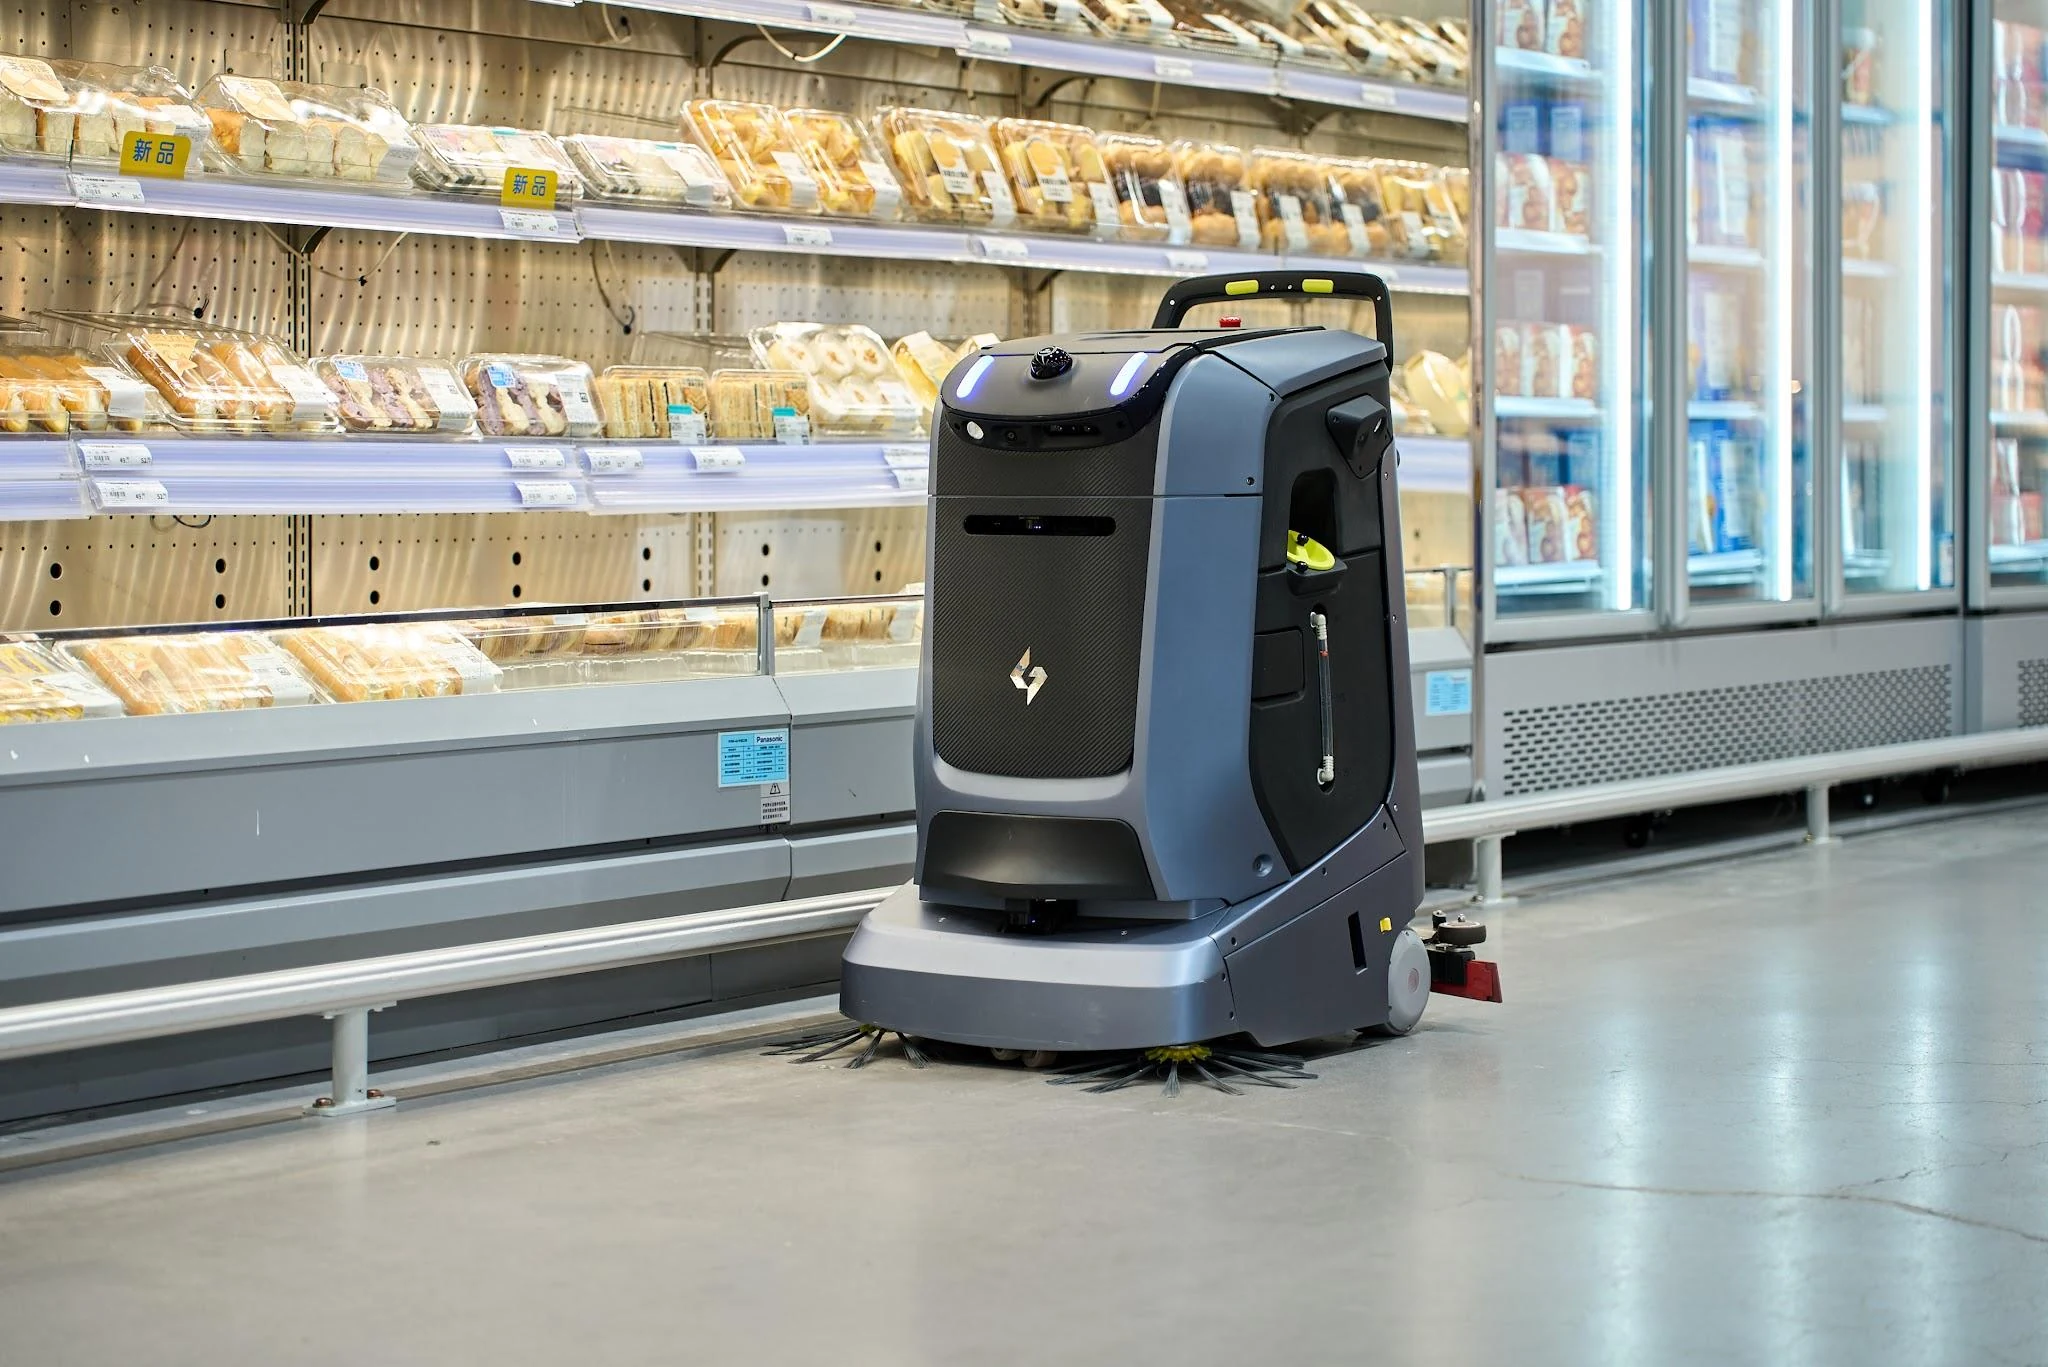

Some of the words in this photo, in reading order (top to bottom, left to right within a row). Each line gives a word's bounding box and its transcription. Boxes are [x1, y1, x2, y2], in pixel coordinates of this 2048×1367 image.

[132, 138, 175, 165] 新品
[512, 173, 546, 196] 新品
[756, 735, 783, 743] Panasonic
